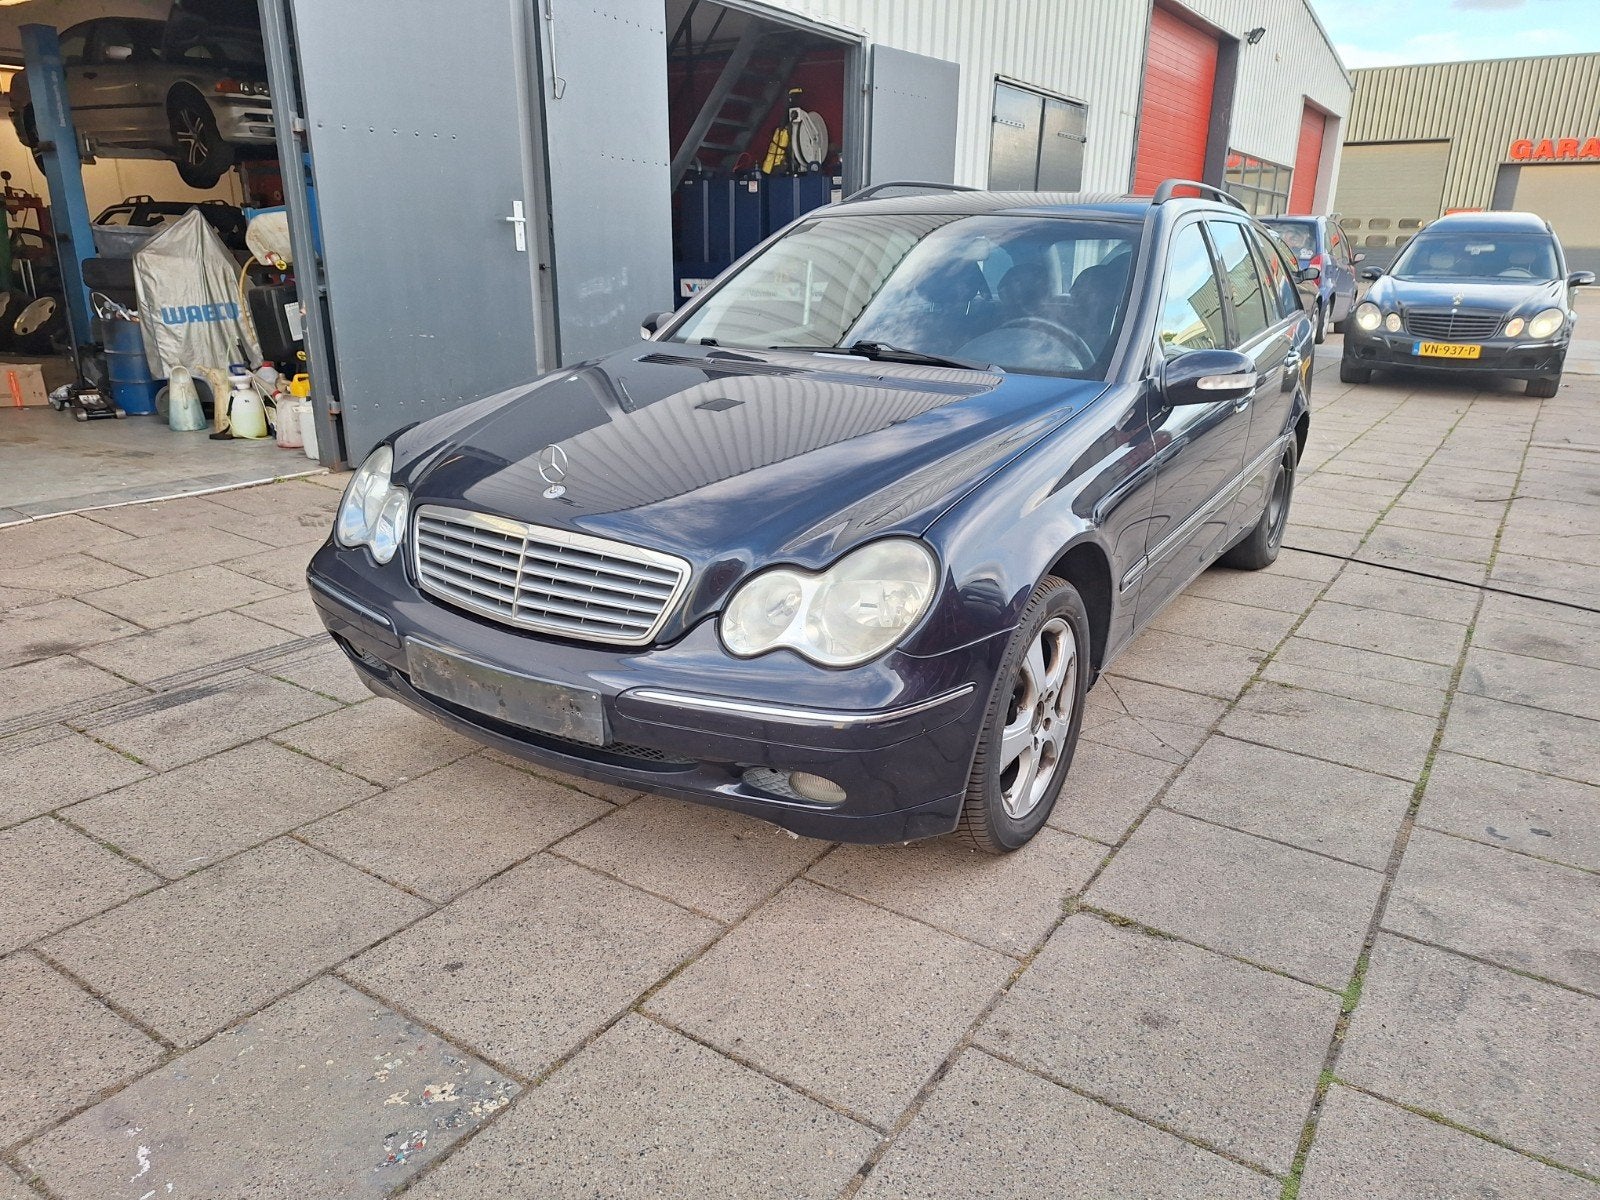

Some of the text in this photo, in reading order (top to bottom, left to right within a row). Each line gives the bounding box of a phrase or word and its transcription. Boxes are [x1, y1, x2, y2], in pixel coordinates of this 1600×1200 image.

[1510, 138, 1600, 159] GARA
[160, 302, 239, 325] WAECO
[1423, 343, 1477, 356] VN-937-P
